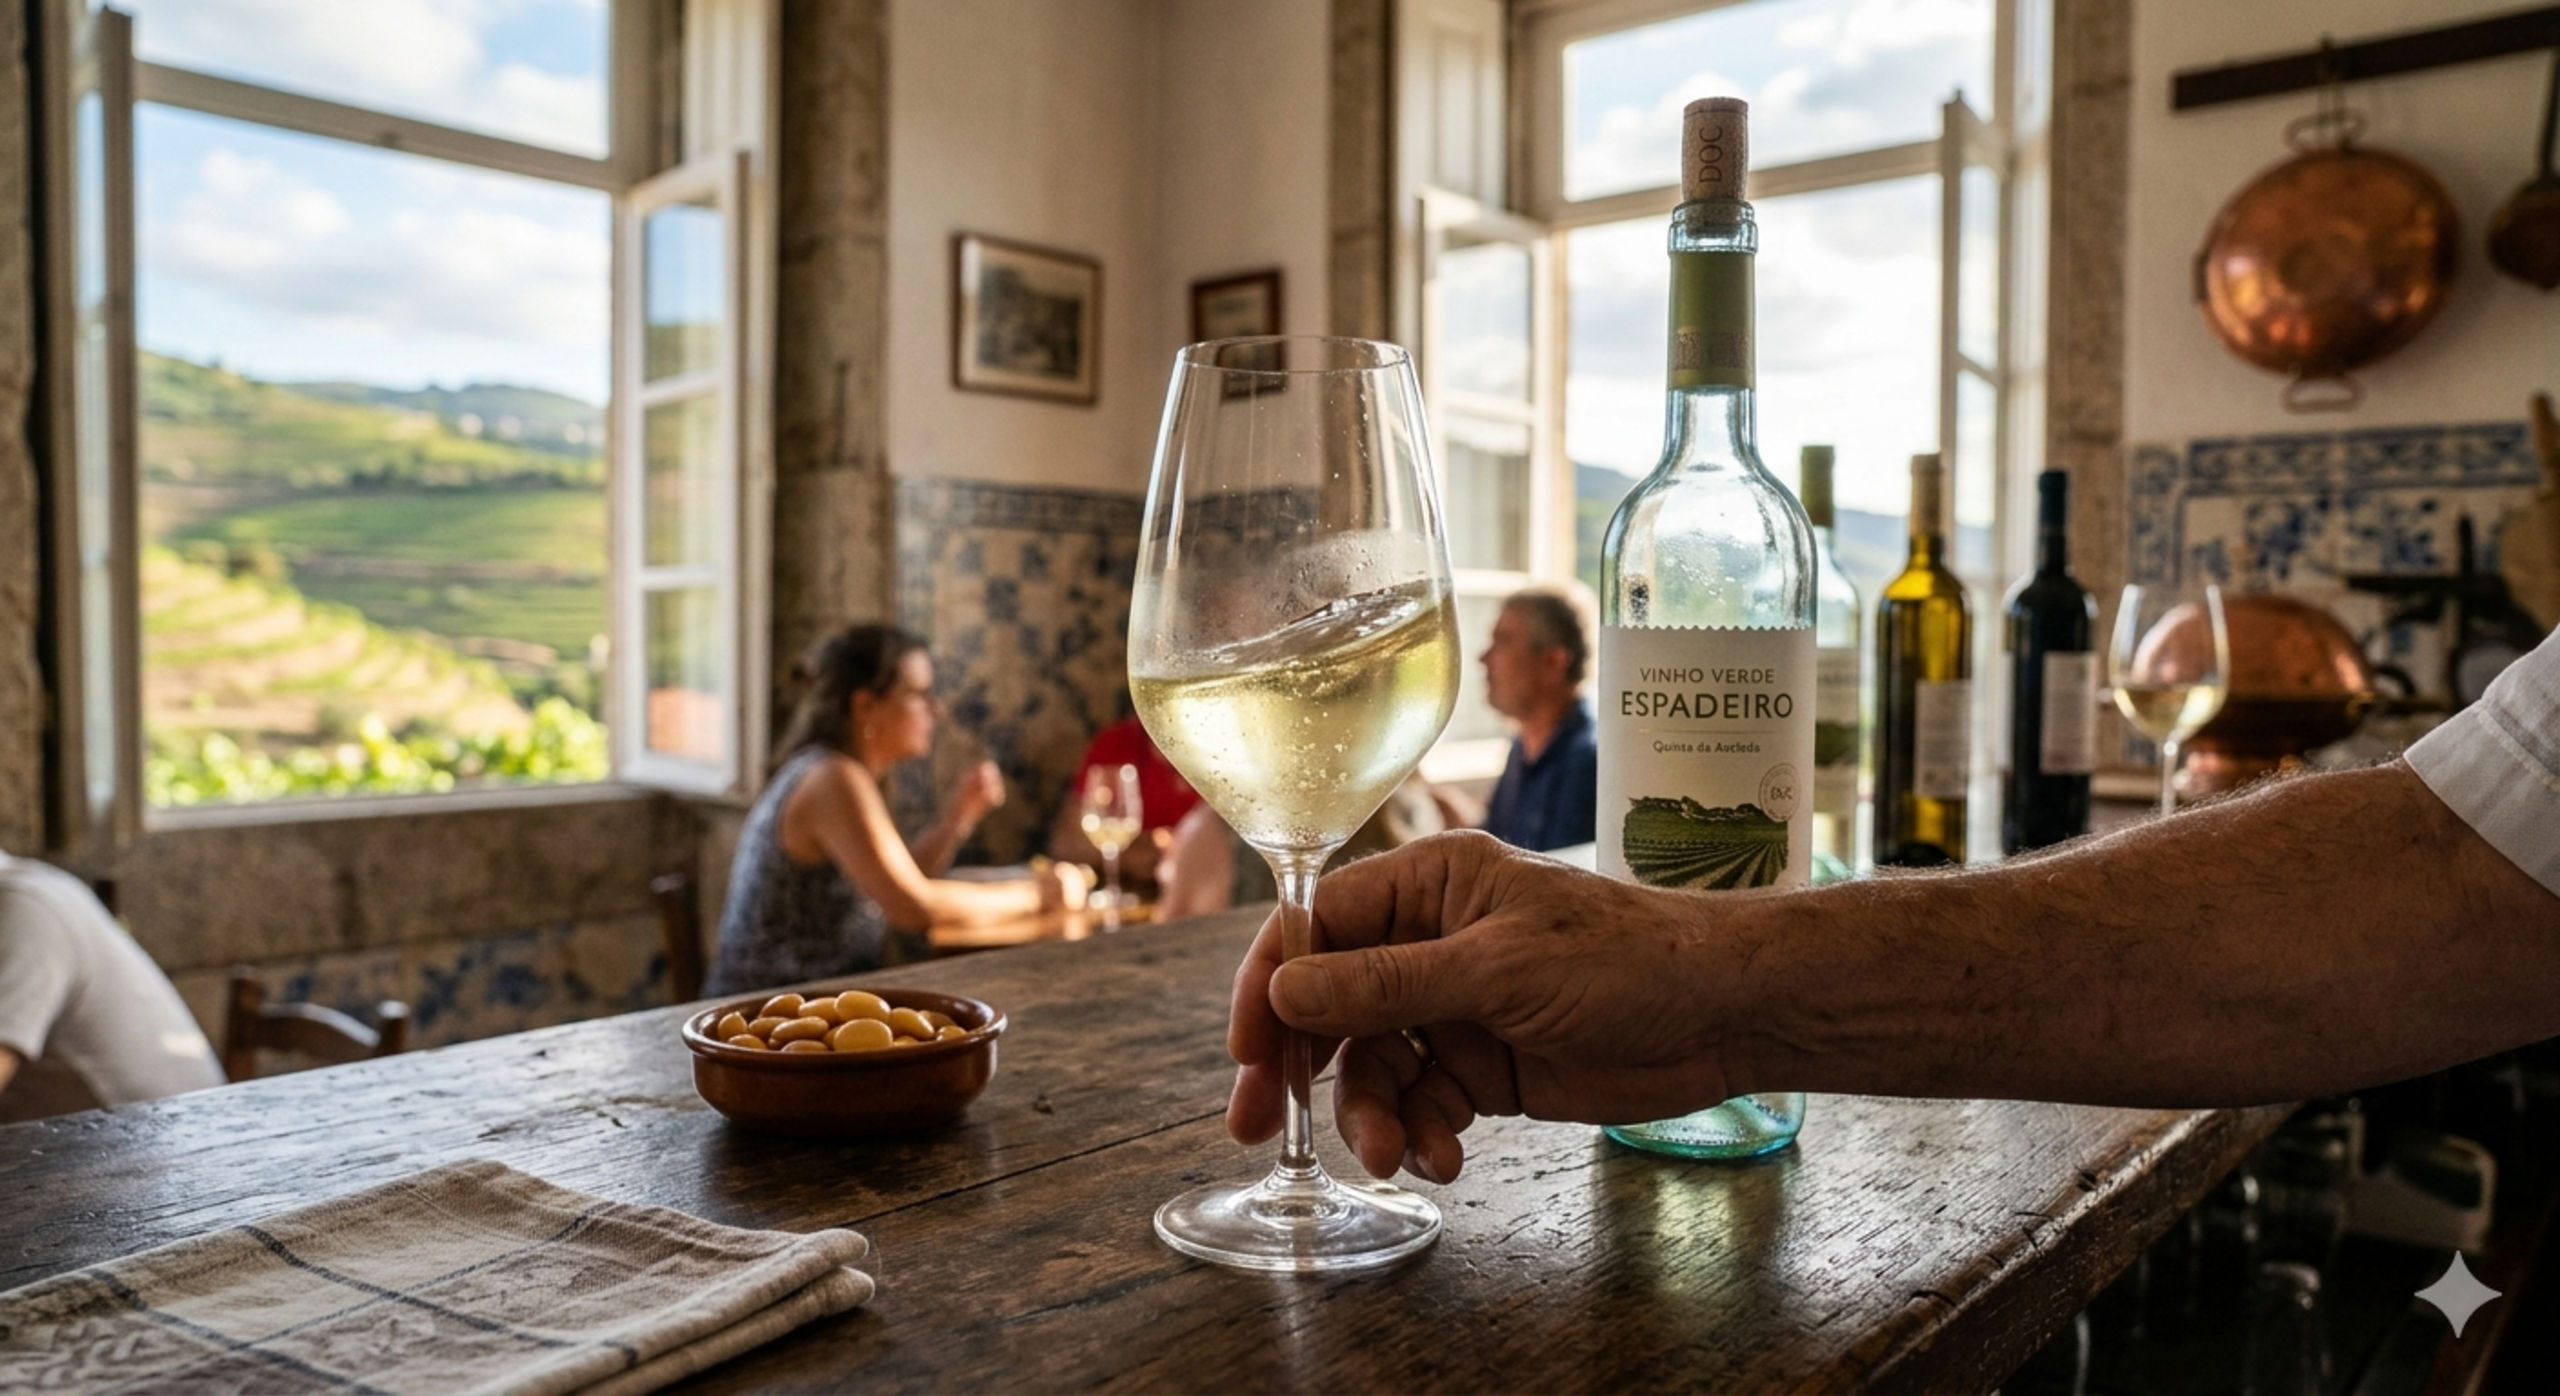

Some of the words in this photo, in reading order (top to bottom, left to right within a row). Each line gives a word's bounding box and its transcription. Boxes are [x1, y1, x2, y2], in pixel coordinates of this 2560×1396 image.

[1699, 125, 1723, 184] DOC
[1639, 667, 1704, 684] VINHO
[1711, 668, 1775, 684] VERDE
[1621, 690, 1793, 719] ESPADEIRO
[1653, 740, 1693, 753] Quinta
[1697, 742, 1711, 753] da
